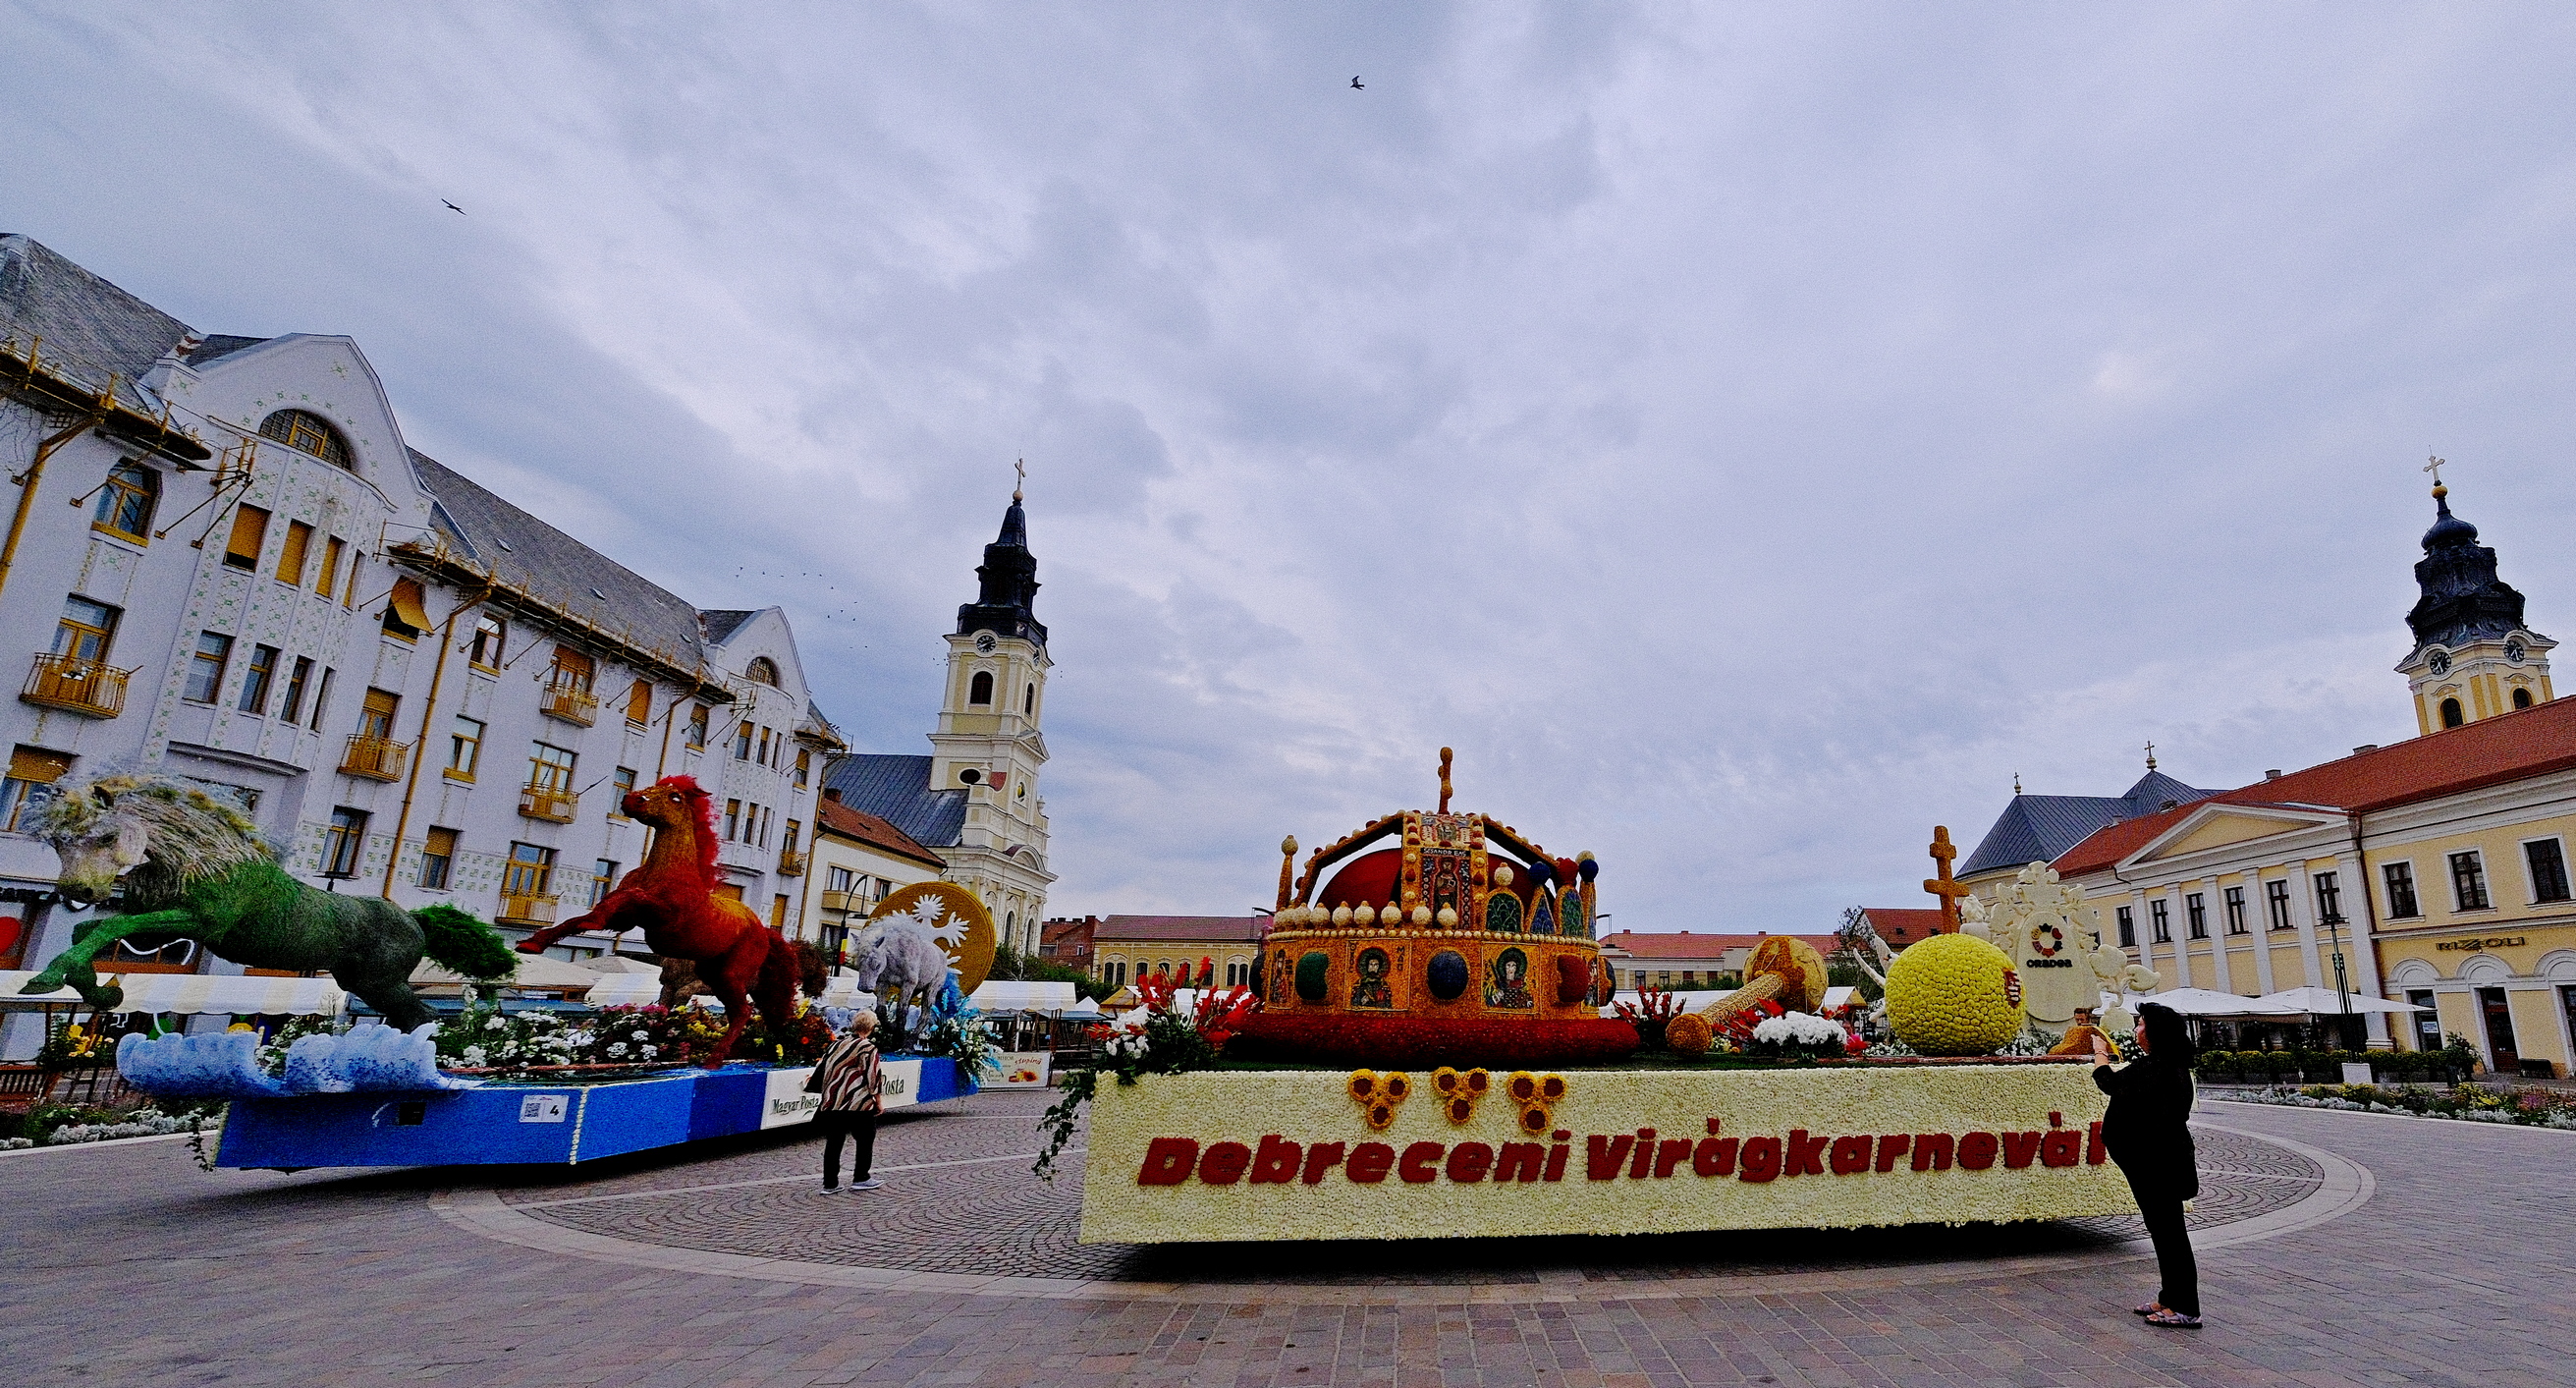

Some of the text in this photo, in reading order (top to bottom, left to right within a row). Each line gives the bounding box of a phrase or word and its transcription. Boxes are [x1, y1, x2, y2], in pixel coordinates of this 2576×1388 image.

[550, 1104, 560, 1116] 4
[771, 1094, 820, 1116] Magyar Posta
[1138, 1111, 2107, 1186] Debreceni Virágkarnevál
